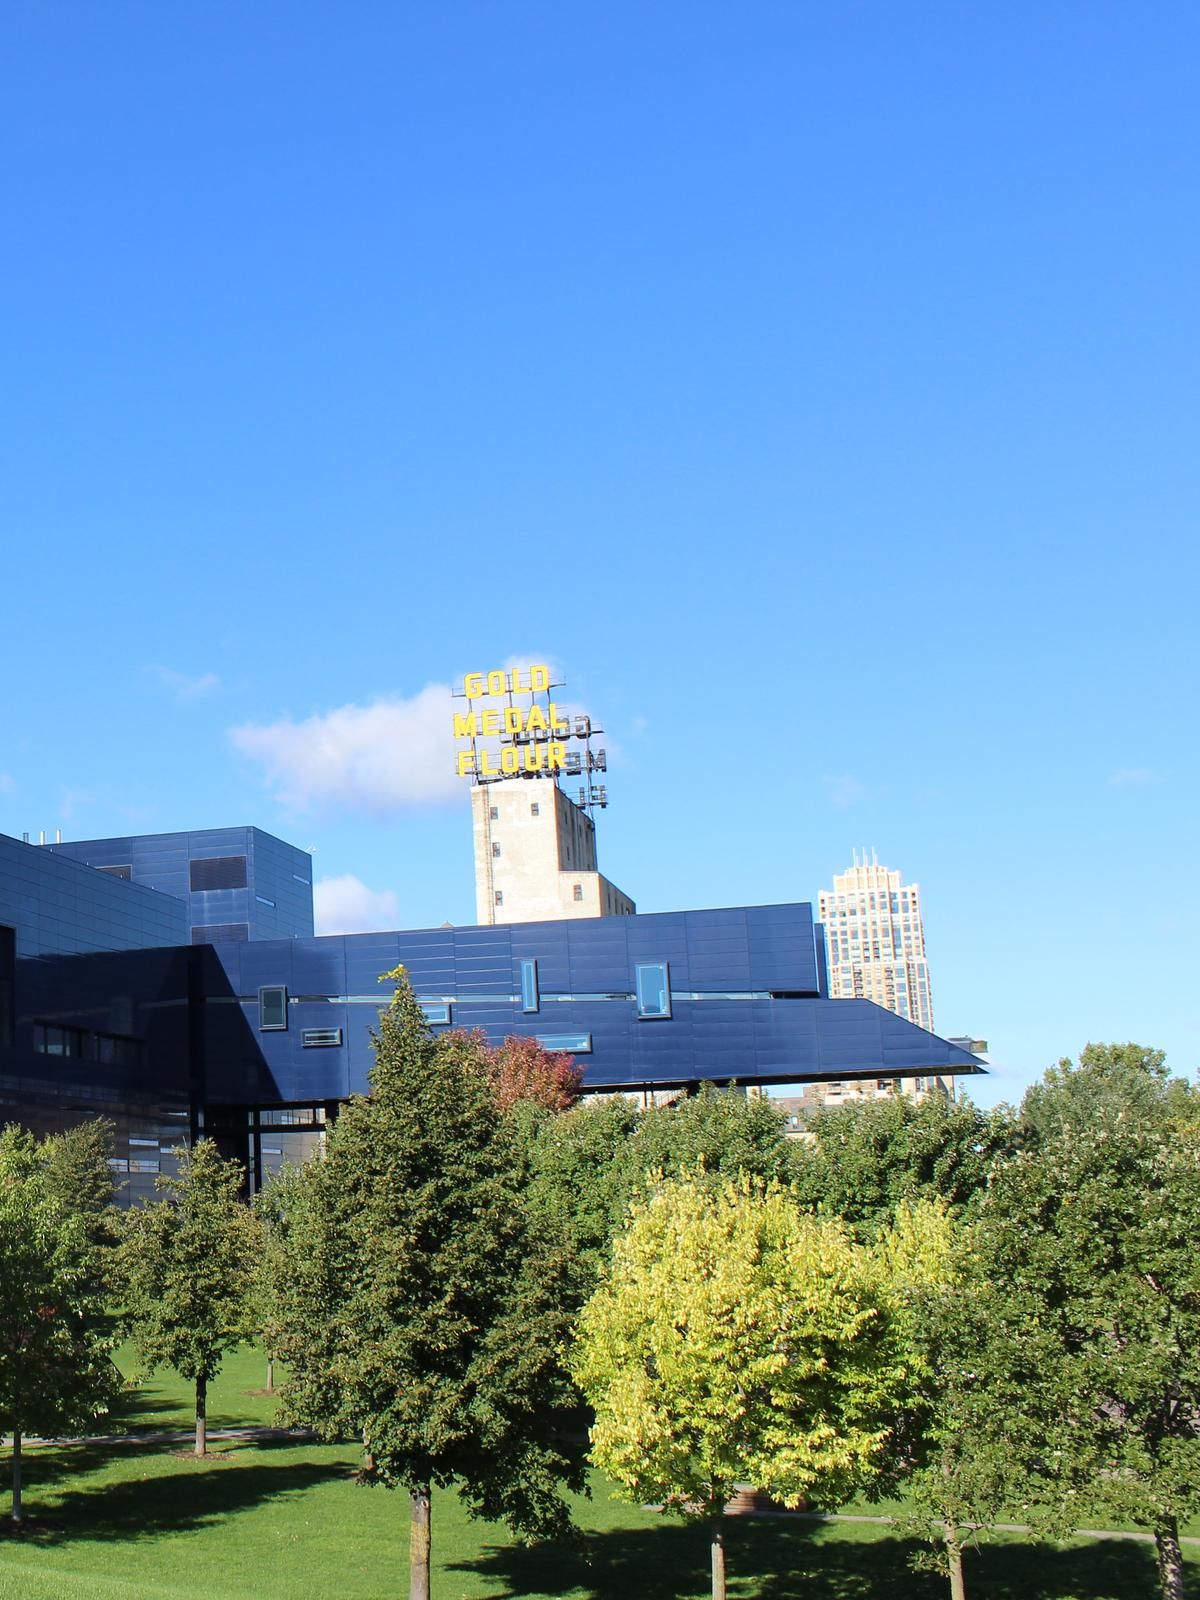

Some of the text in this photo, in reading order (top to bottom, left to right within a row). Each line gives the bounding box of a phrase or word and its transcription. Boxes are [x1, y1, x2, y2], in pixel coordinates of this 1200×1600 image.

[464, 665, 549, 699] GOLD
[453, 703, 568, 739] MEDAL
[458, 742, 567, 777] FLOUR
